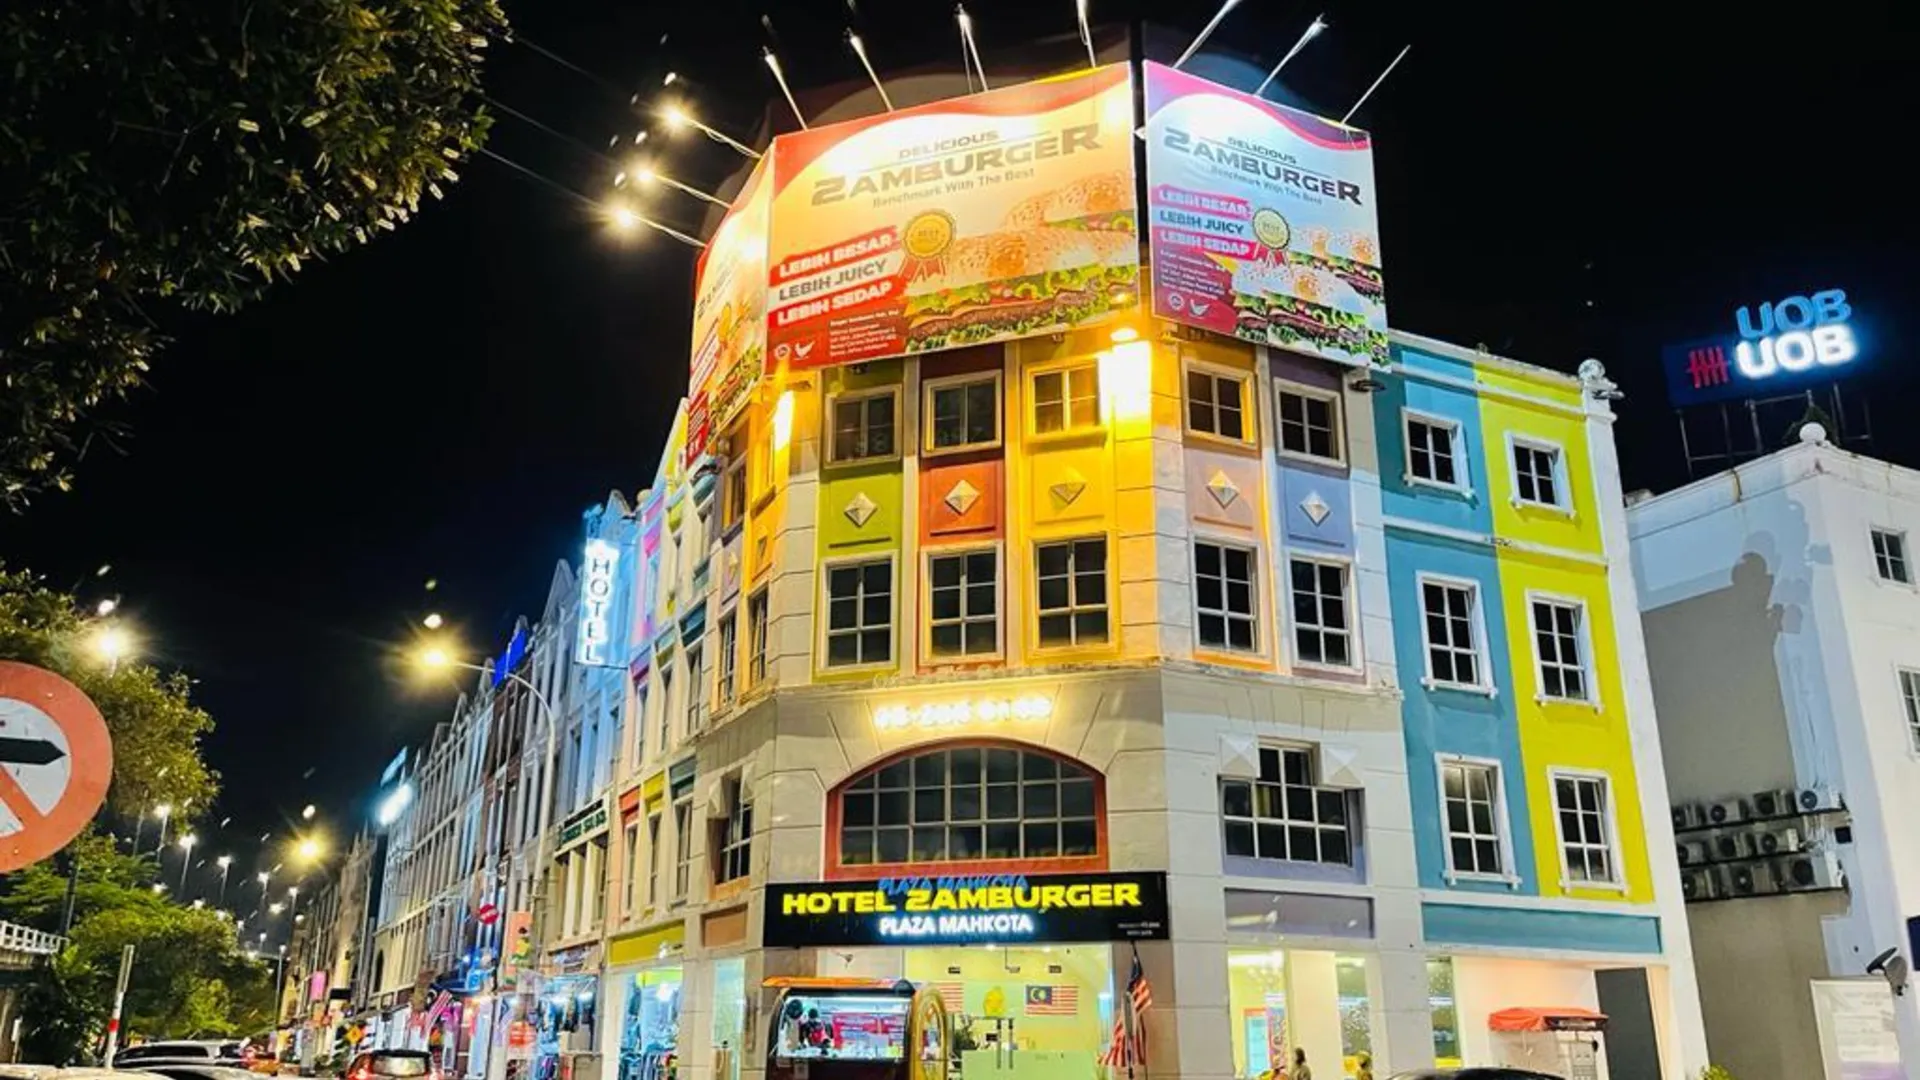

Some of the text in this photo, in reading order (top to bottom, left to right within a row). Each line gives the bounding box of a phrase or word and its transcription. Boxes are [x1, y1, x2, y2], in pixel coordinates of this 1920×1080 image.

[899, 130, 999, 159] DELICIOUS
[945, 178, 974, 193] With
[979, 173, 1002, 187] The
[1005, 167, 1035, 182] Best
[1160, 209, 1245, 235] LEBIH JUICY
[779, 252, 831, 278] LEBIH
[779, 257, 887, 301] LEBIH JUICY
[777, 297, 830, 327] LEBIH
[832, 280, 893, 310] SEDAP
[1736, 288, 1852, 339] UOB
[1735, 323, 1858, 380] UOB
[585, 557, 611, 663] HOTEL
[782, 890, 897, 915] HOTEL
[879, 913, 1035, 936] PLAZA MAHKOTA
